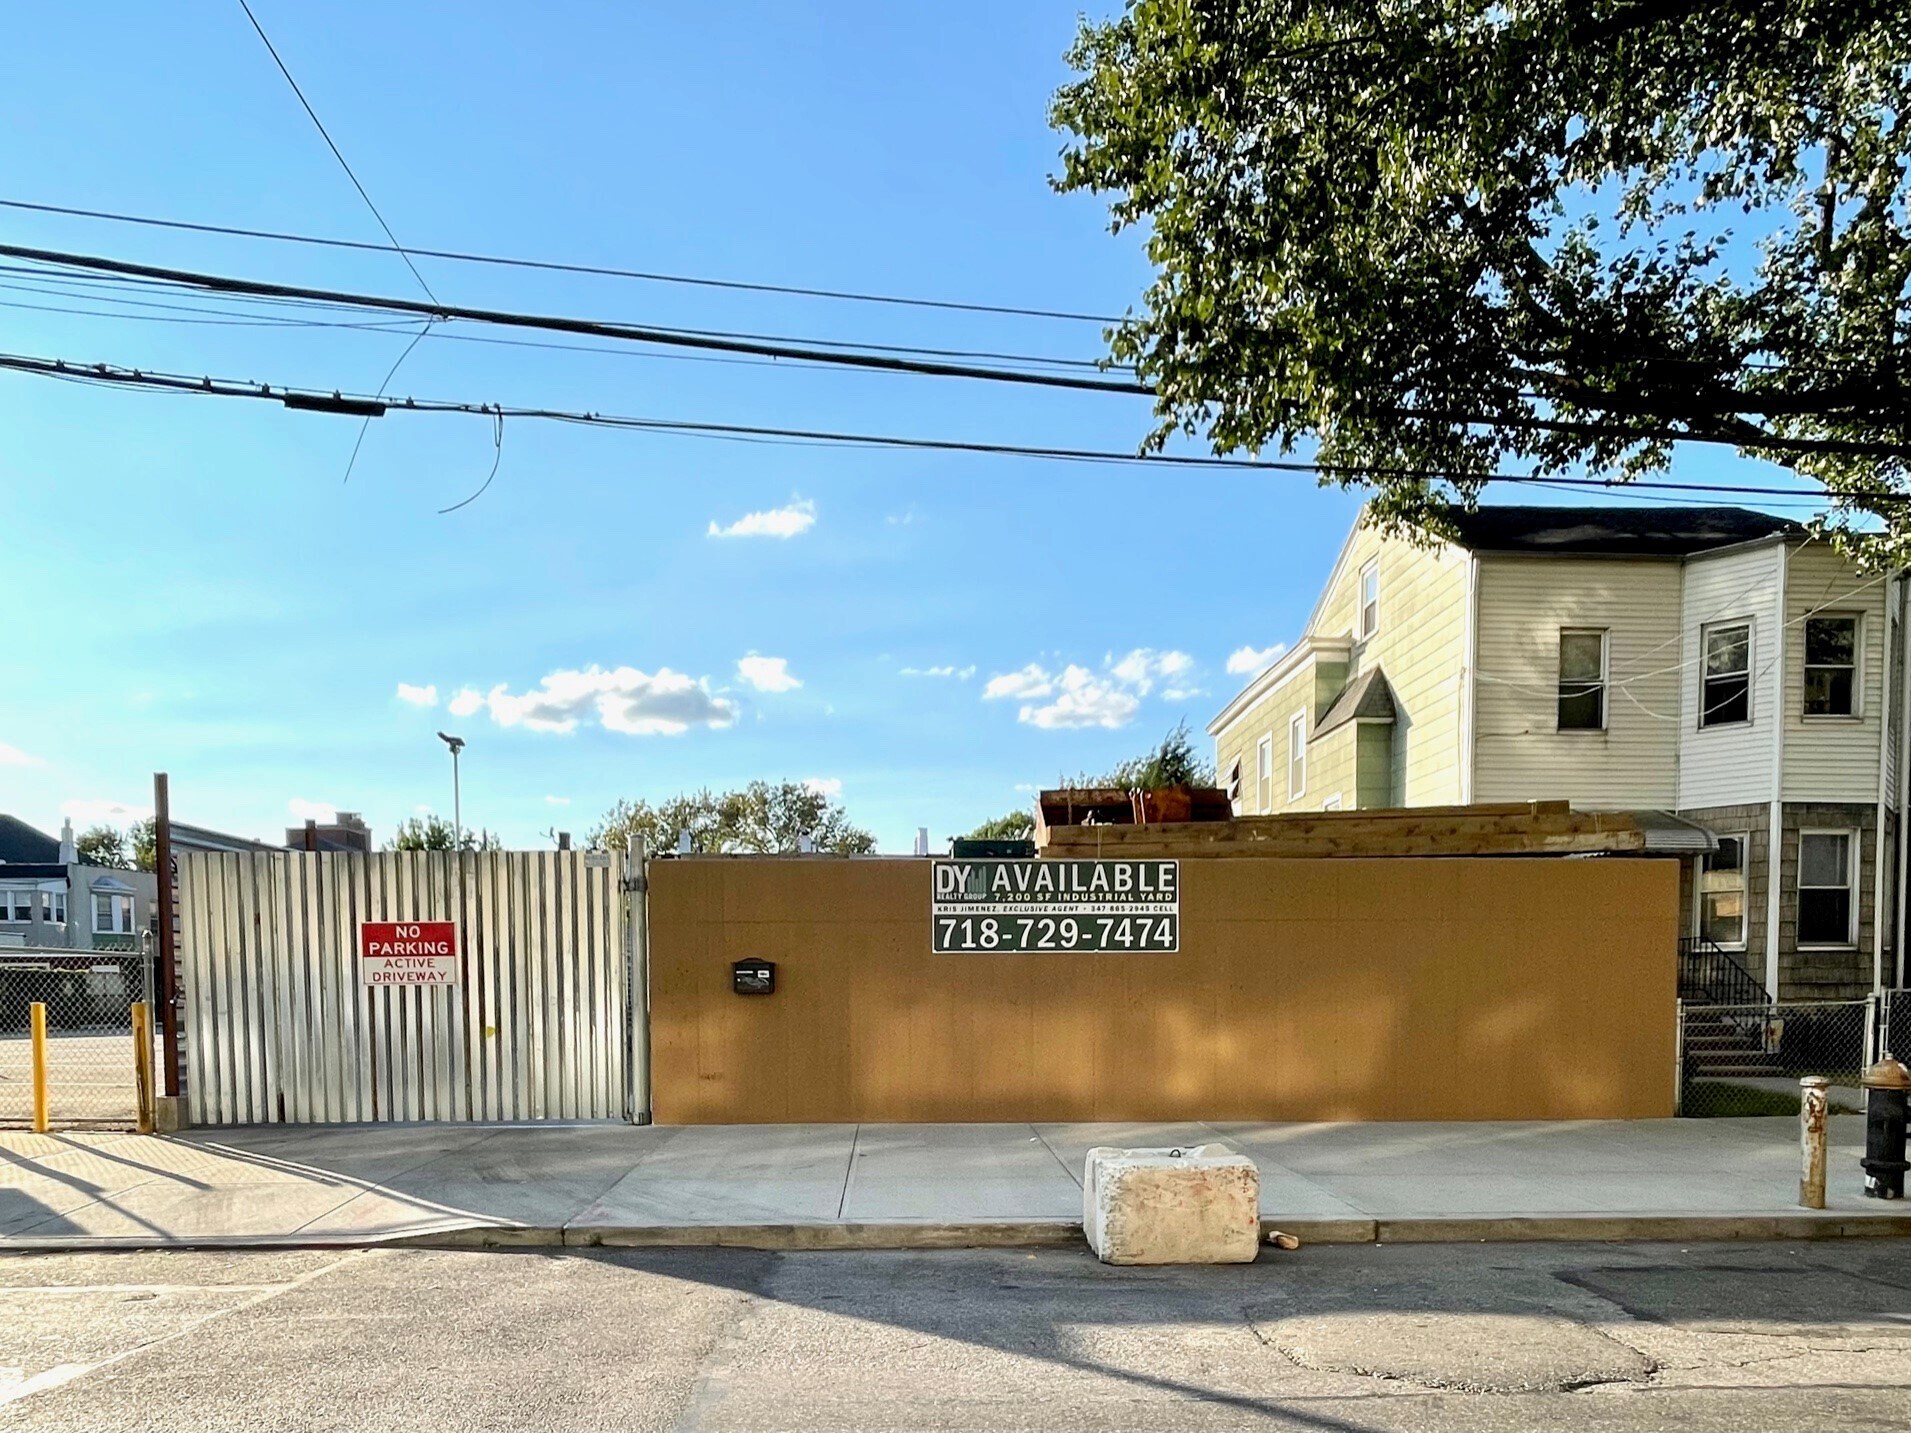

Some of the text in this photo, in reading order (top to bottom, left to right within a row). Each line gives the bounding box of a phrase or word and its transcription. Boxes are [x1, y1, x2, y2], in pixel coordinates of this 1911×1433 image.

[991, 864, 1175, 892] AVAILABLE
[937, 892, 987, 900] REALTY GROUP
[994, 893, 1173, 902] 7,200 SF INDUSTRIAL YARD
[395, 925, 421, 938] NO
[939, 918, 1173, 948] 718-729-7474
[369, 941, 449, 955] PARKING
[384, 958, 436, 968] ACTIVE
[372, 971, 447, 982] DRIVEWAY
